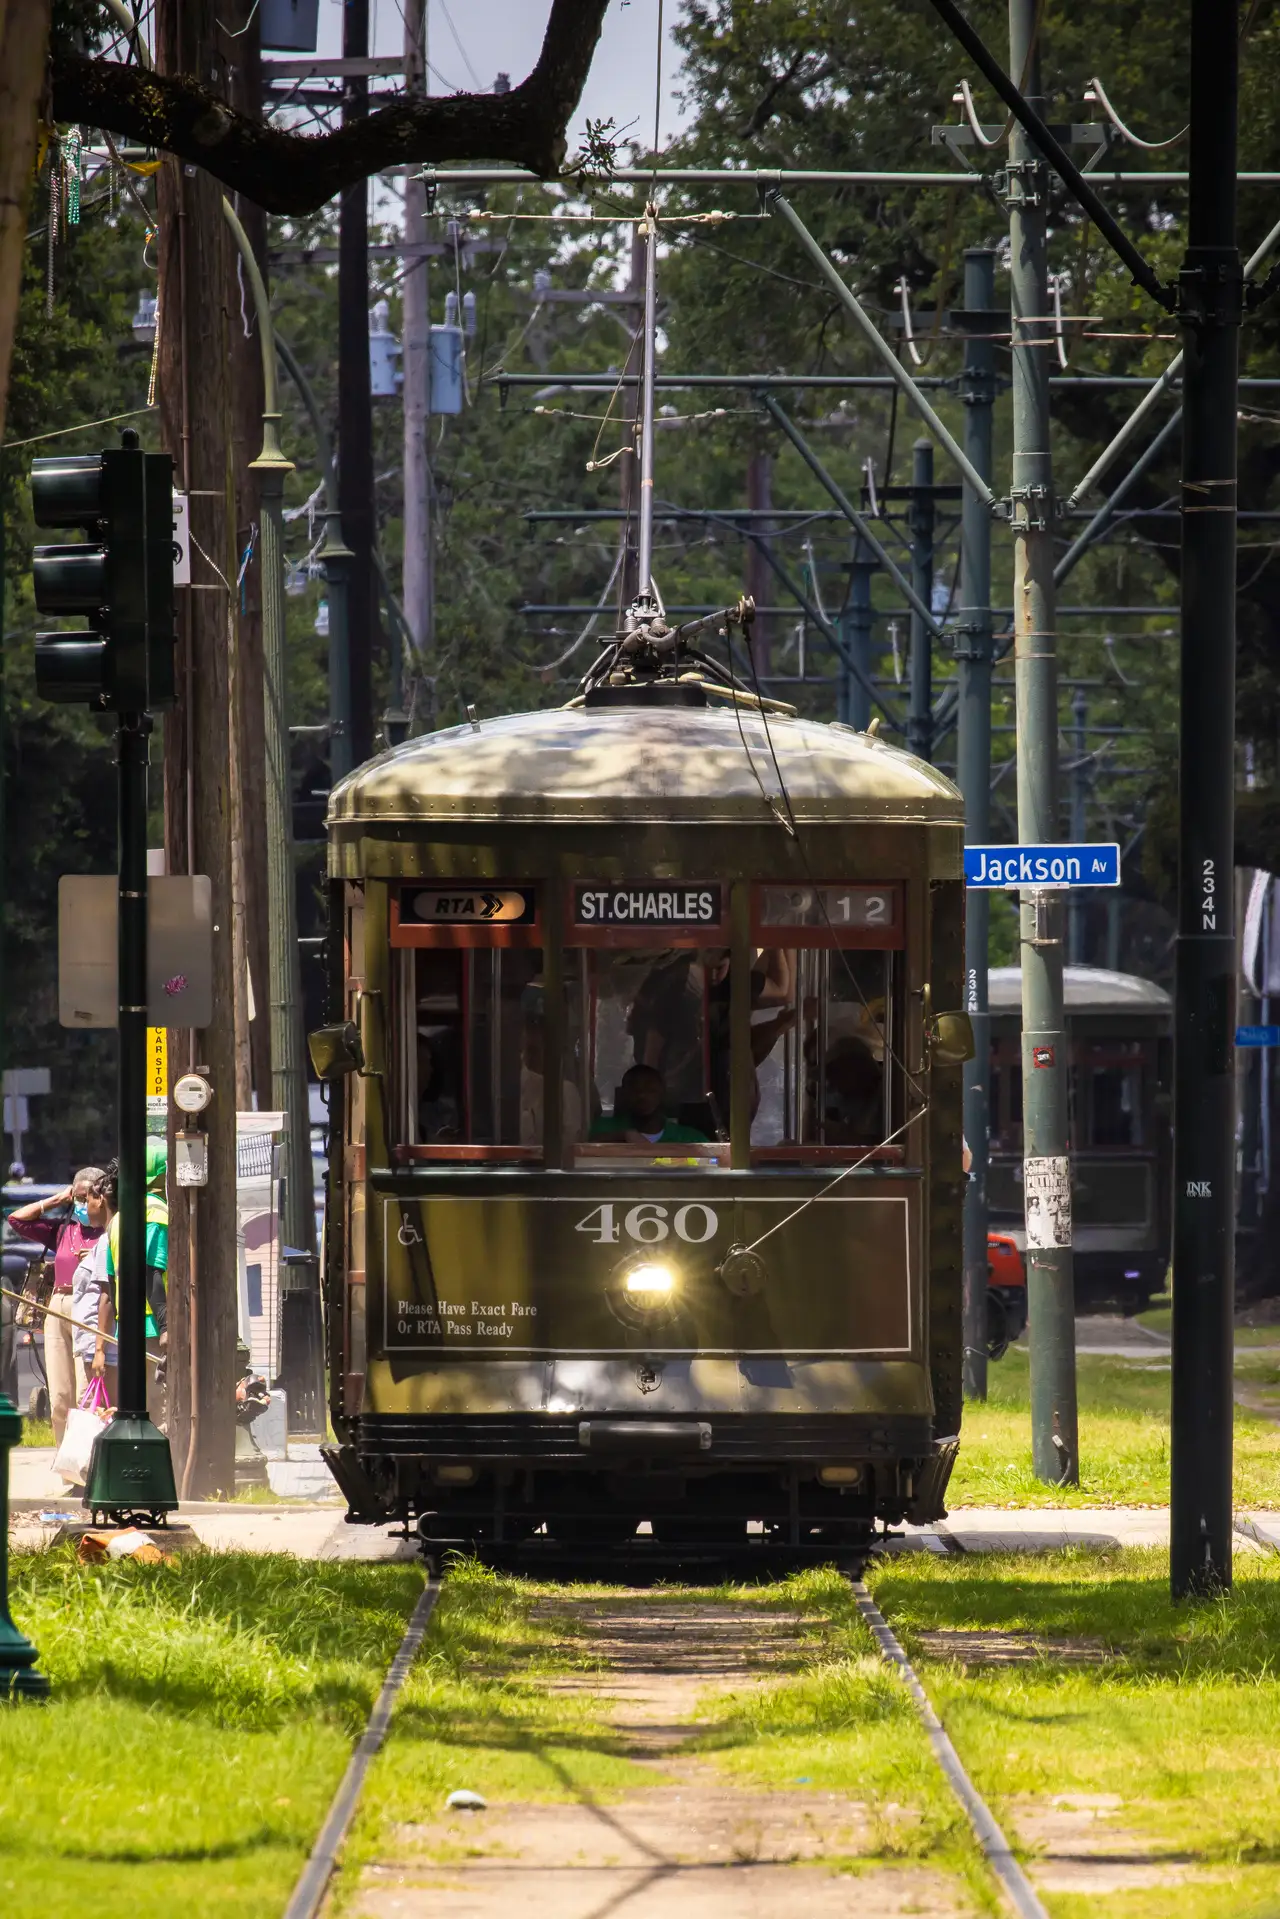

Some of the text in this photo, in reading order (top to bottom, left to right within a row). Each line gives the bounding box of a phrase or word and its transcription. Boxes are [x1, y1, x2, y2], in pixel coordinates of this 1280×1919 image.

[972, 853, 1107, 882] Jackson Av
[435, 898, 476, 914] RTA
[581, 892, 713, 919] ST.CHARLES
[1202, 859, 1216, 930] 234N
[968, 968, 978, 1012] 232N
[155, 1058, 163, 1094] STOP
[574, 1204, 719, 1243] 460
[398, 1300, 537, 1316] Please Have Exact Fare
[397, 1319, 514, 1338] Or RTA Pass Ready
